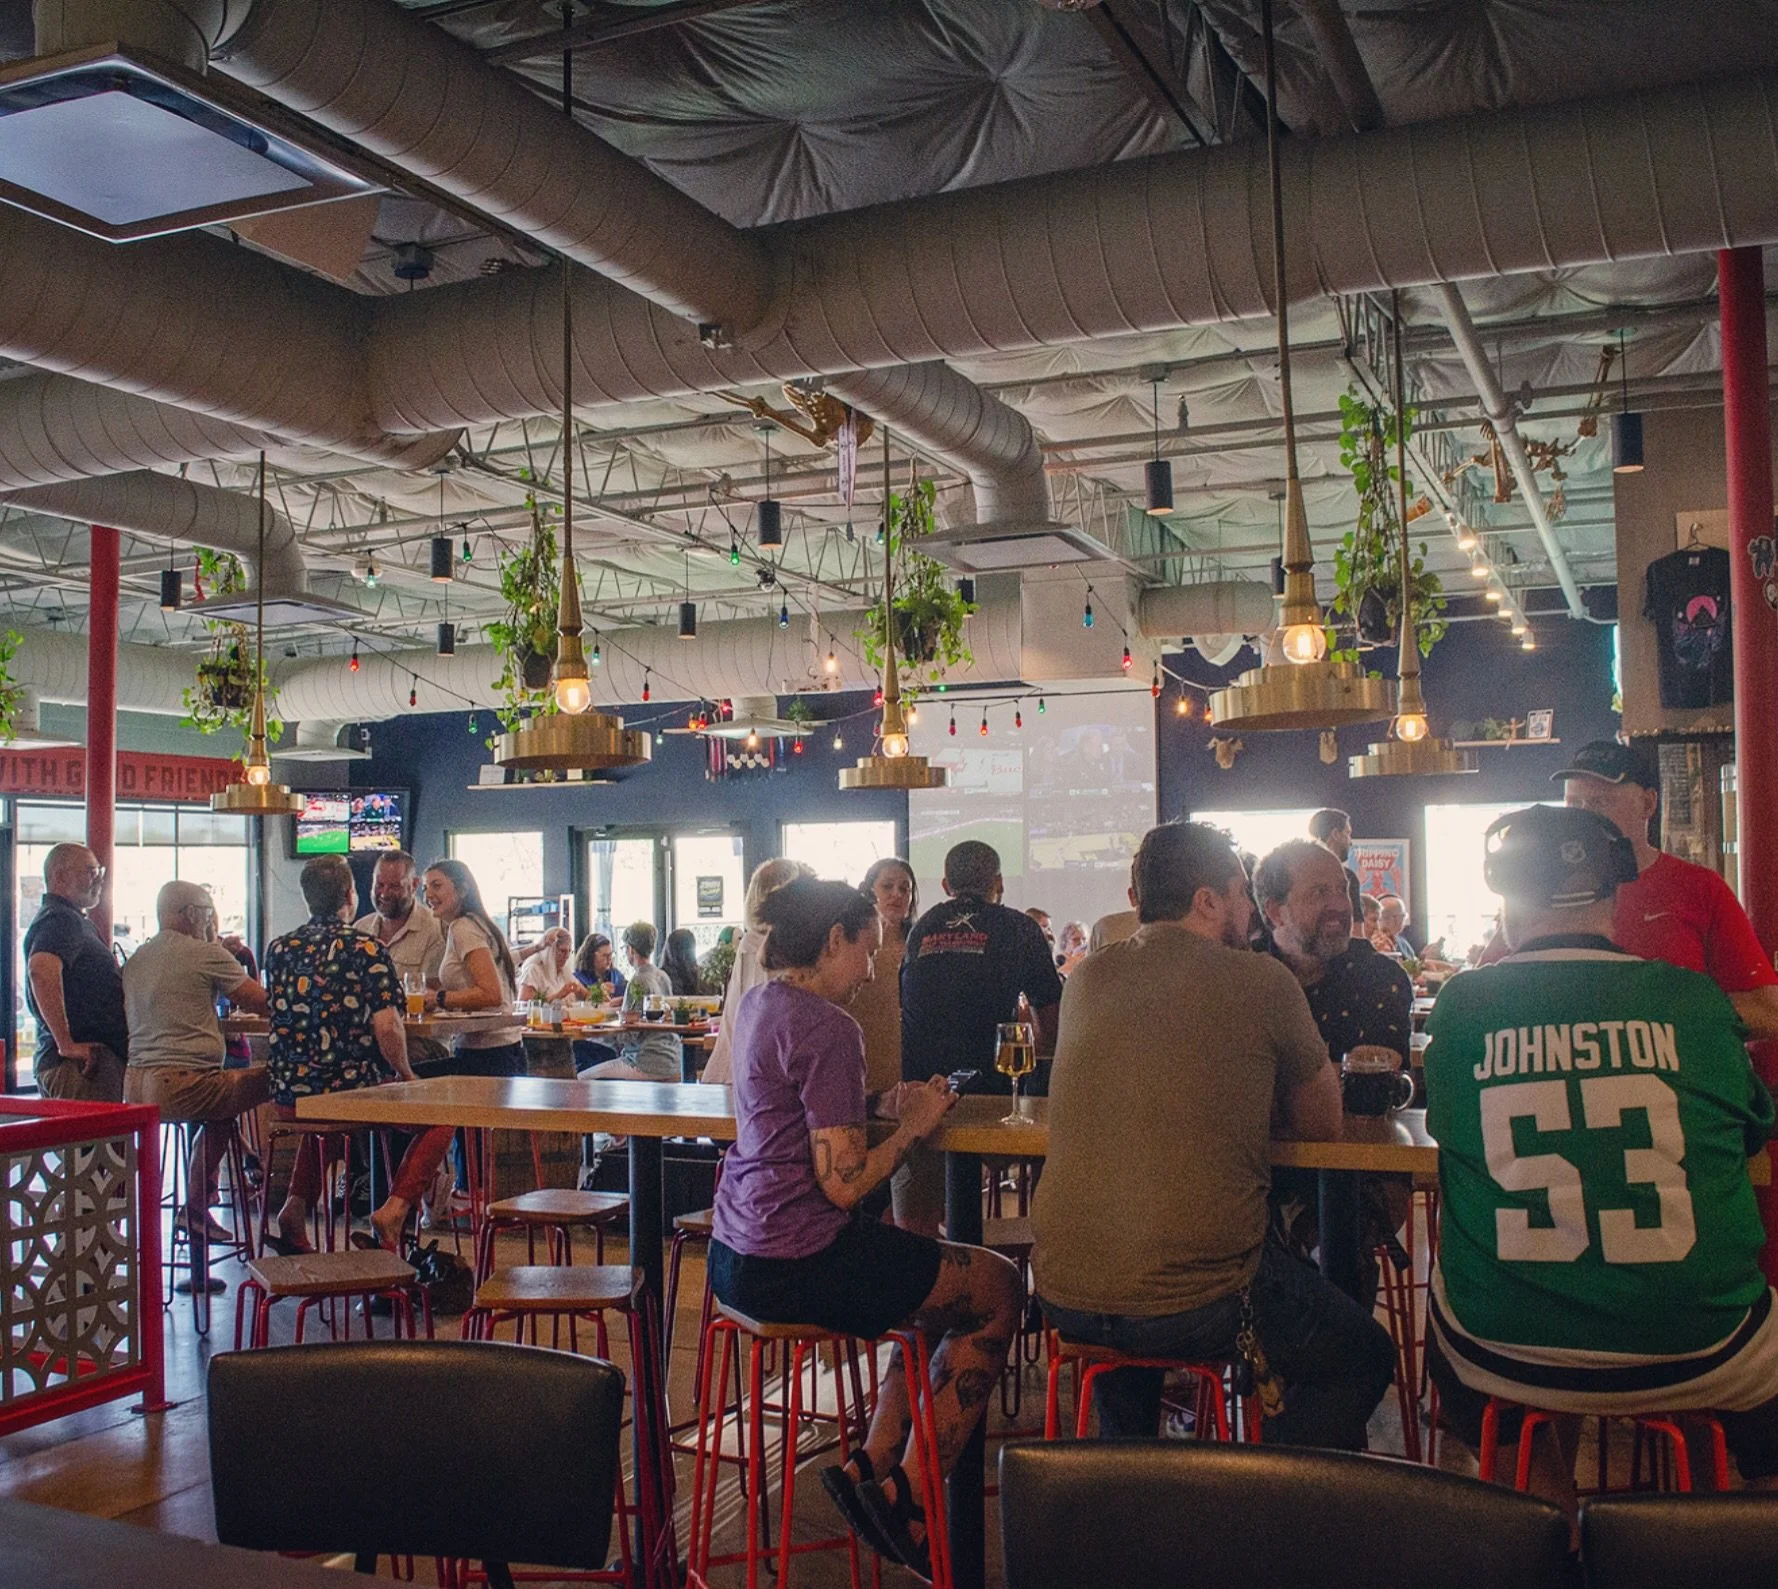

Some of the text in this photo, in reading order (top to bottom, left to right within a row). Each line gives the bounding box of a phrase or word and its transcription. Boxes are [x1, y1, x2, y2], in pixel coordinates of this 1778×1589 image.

[0, 757, 57, 786] ITH
[66, 761, 136, 790] GD
[1361, 859, 1391, 869] DAISY
[1473, 1020, 1680, 1080] JOHNSTON
[1480, 1073, 1697, 1263] 53
